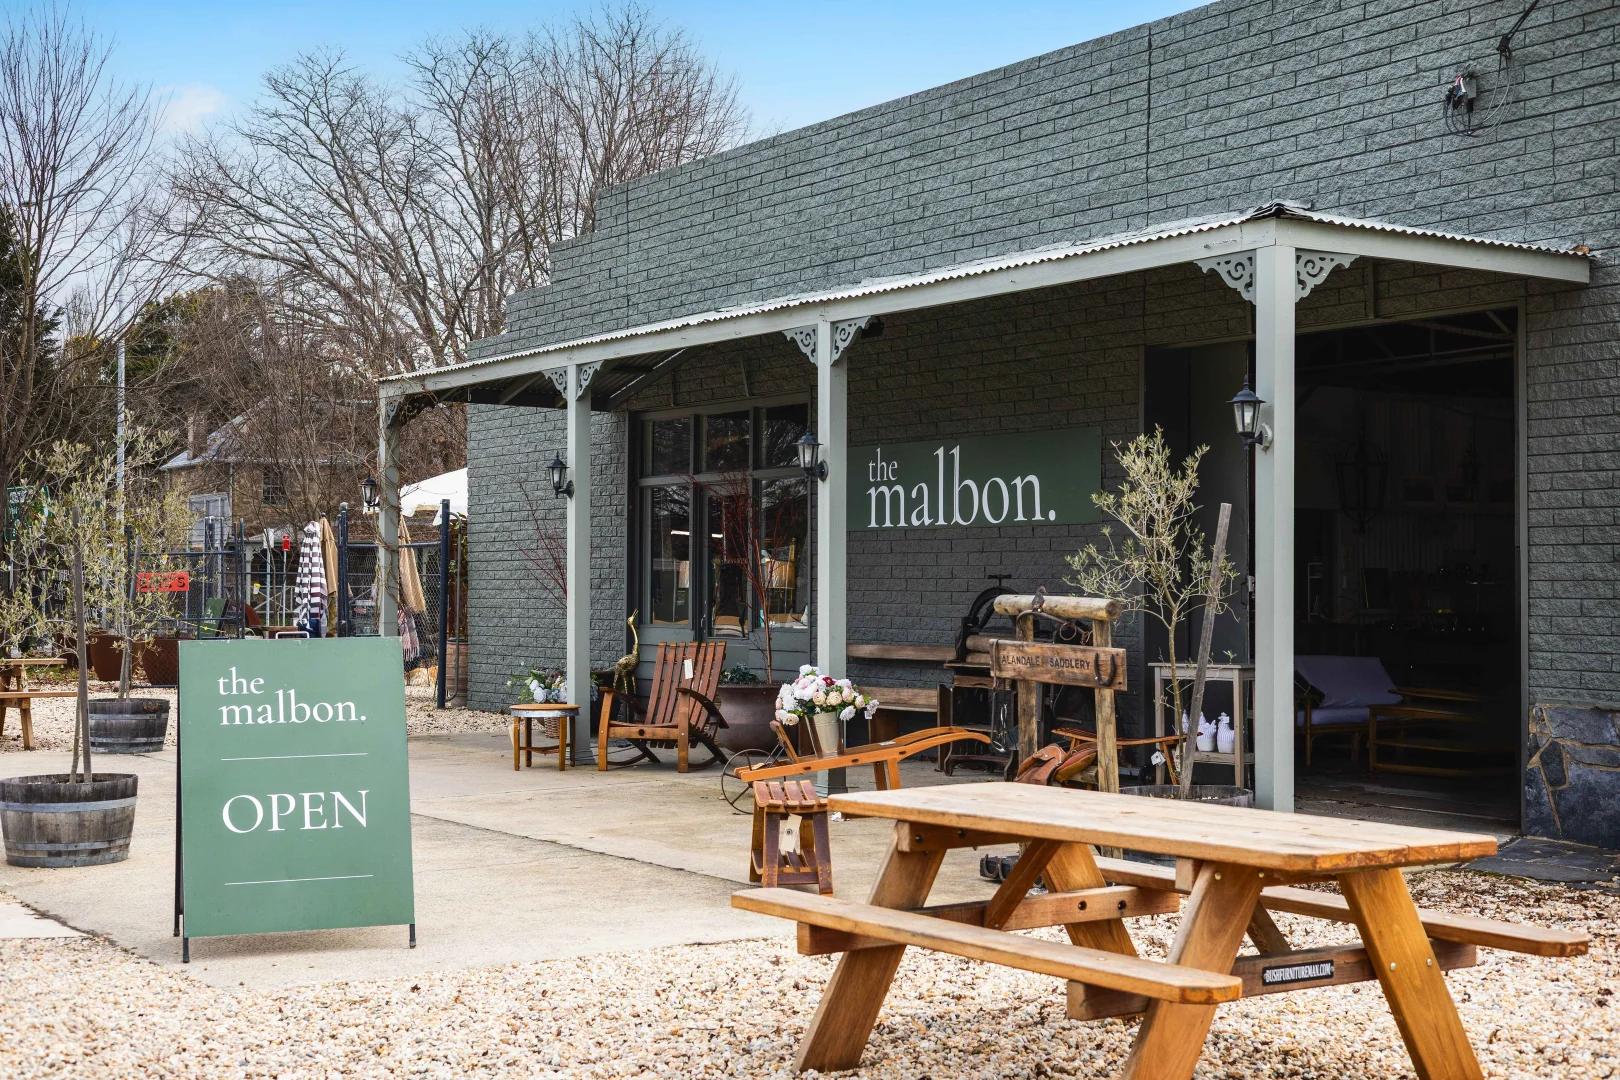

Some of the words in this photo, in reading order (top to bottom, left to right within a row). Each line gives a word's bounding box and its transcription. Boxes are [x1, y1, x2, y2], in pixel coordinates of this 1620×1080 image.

[868, 447, 898, 482] the
[866, 444, 1057, 528] malbon.
[217, 666, 265, 695] the
[1001, 655, 1040, 667] ALANDALE
[1049, 657, 1091, 670] SADDLERY
[218, 689, 367, 726] malbon.
[222, 789, 370, 834] OPEN
